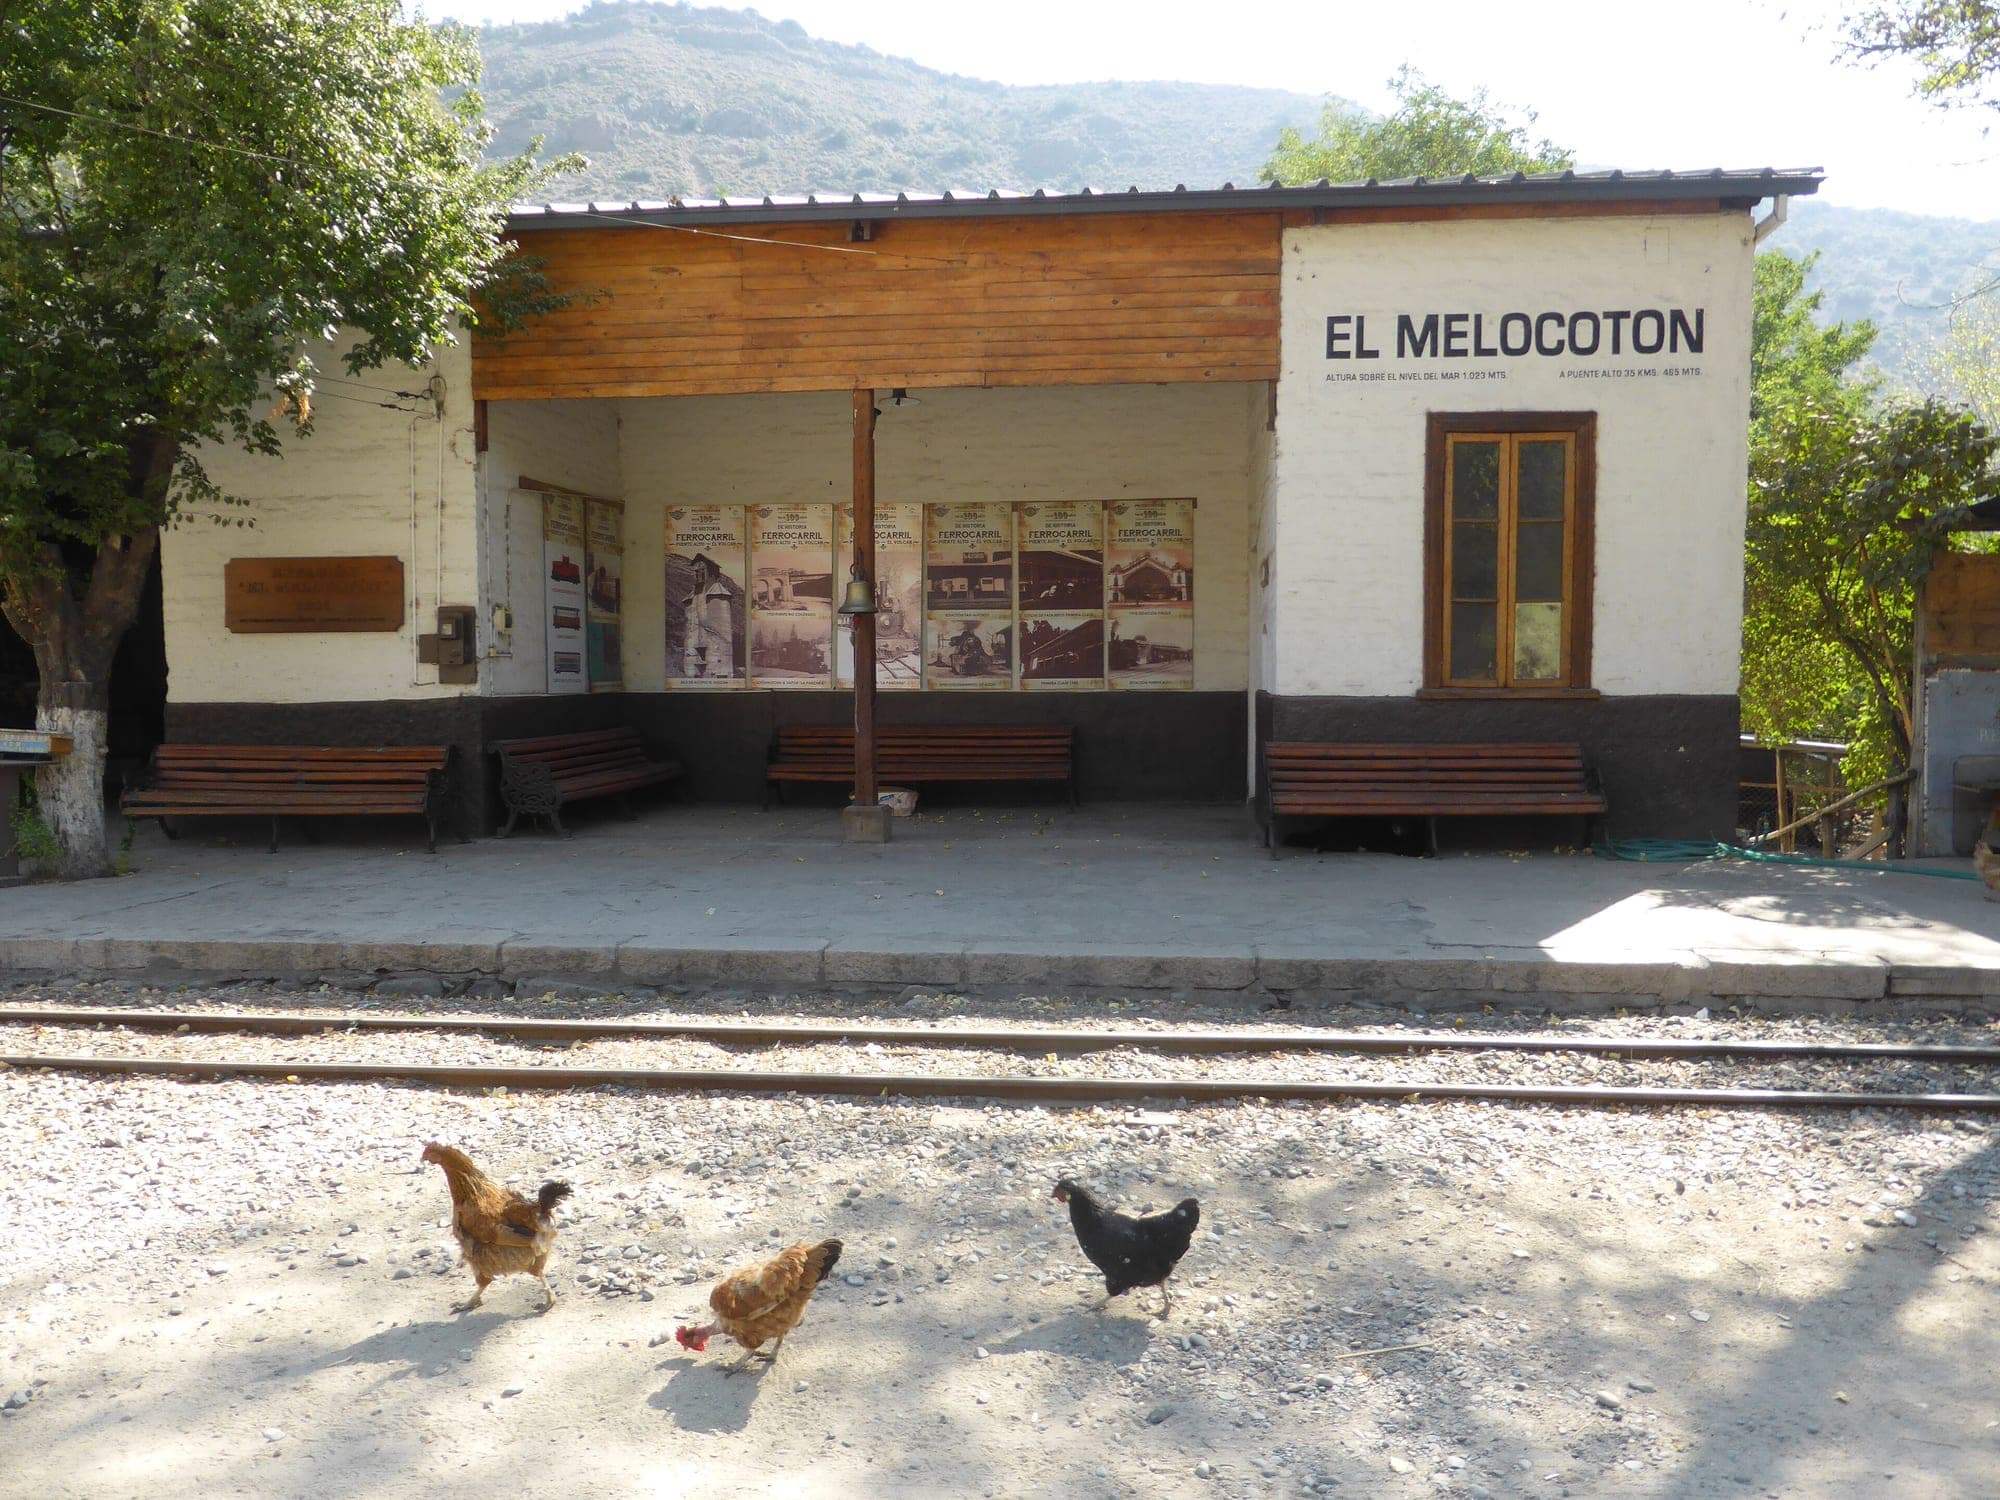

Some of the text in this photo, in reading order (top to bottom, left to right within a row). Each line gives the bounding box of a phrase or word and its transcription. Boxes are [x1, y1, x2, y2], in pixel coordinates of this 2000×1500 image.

[1325, 308, 1704, 359] EL MELOCOTON
[1325, 373, 1357, 382] ALTURA
[1359, 373, 1385, 381] SOBRE
[1387, 372, 1397, 381] EL
[1399, 372, 1423, 381] NIVEL
[1423, 372, 1439, 380] DEL
[1441, 372, 1460, 380] MAR
[1559, 370, 1565, 378] A
[1567, 369, 1599, 378] PUENTE
[1601, 369, 1622, 377] ALTO
[1624, 369, 1635, 377] 35
[761, 532, 823, 540] FERROCARRIL
[938, 530, 1002, 539] FERROCARRIL
[1028, 529, 1093, 539] FERROCARRIL
[1118, 528, 1183, 537] FERROCARRIL
[675, 533, 736, 542] FERROCARRIL
